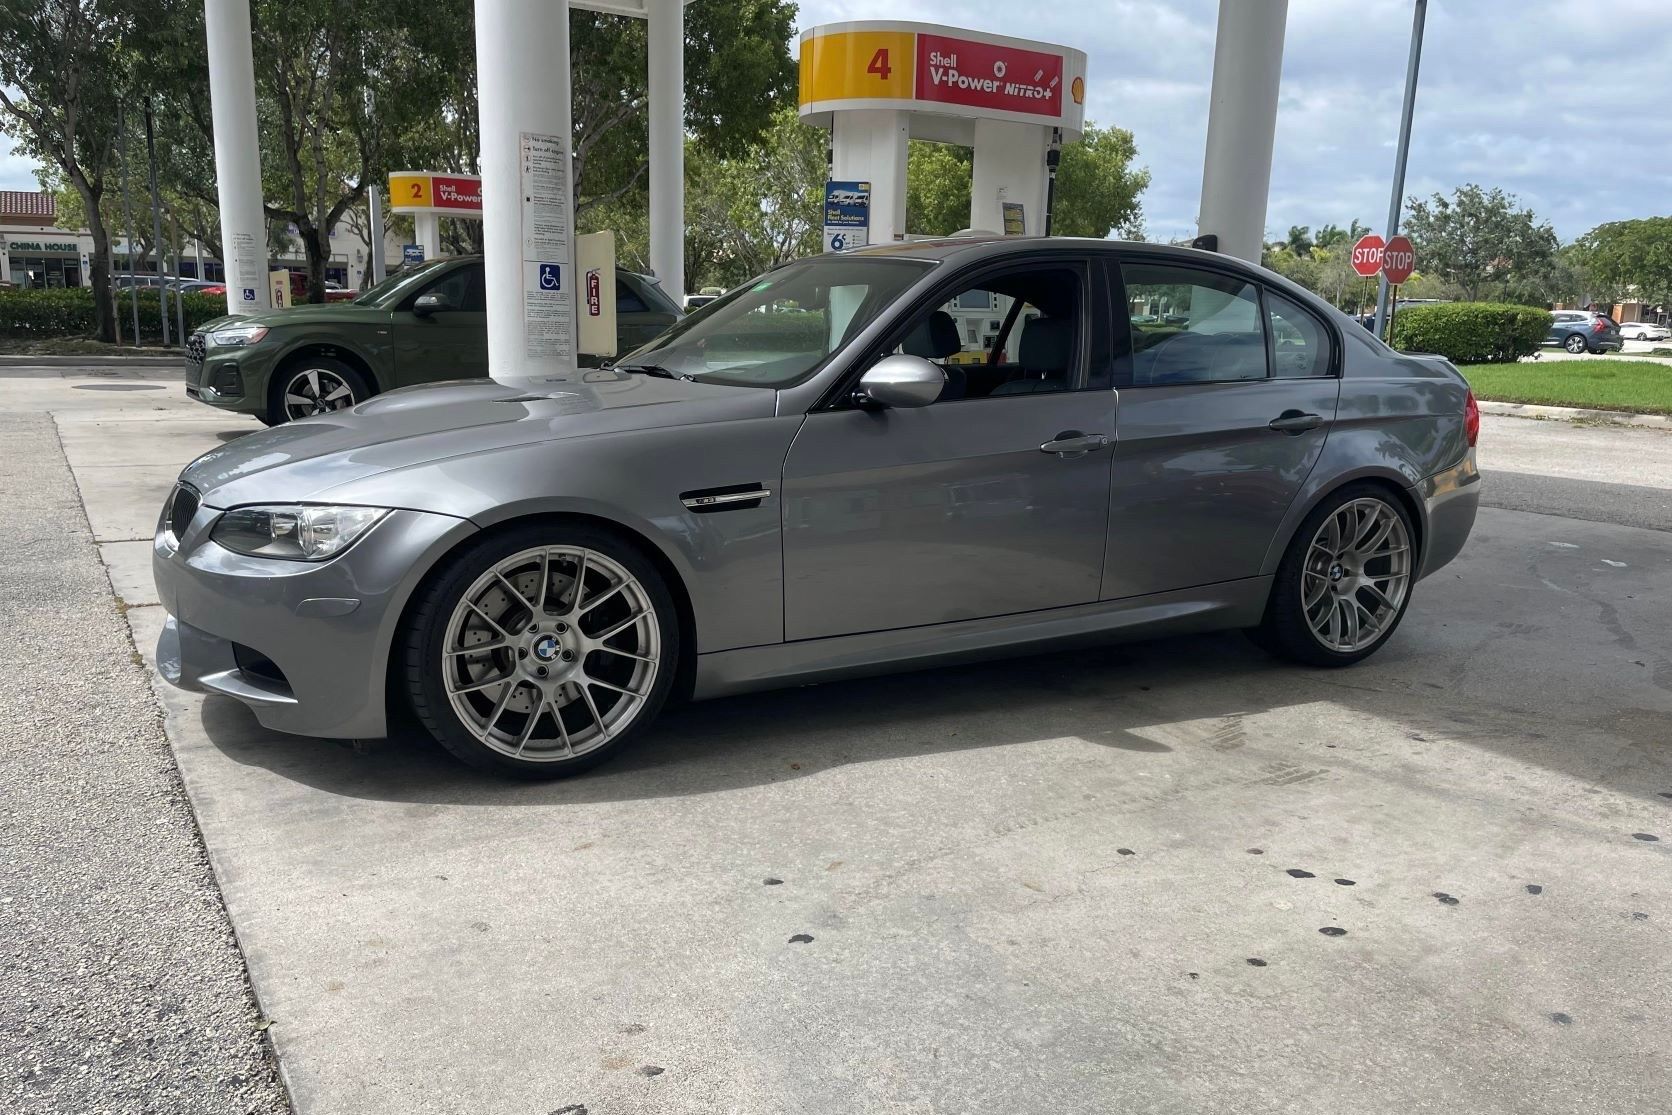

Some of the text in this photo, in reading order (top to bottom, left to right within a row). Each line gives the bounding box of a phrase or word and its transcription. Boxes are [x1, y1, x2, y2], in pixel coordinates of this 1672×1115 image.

[867, 48, 891, 80] 4
[930, 52, 957, 68] Shell
[930, 67, 999, 93] V-Power
[411, 183, 423, 199] 2
[10, 242, 78, 252] CHINA HOUSE
[1384, 251, 1413, 270] STOP
[591, 279, 599, 314] FIRE
